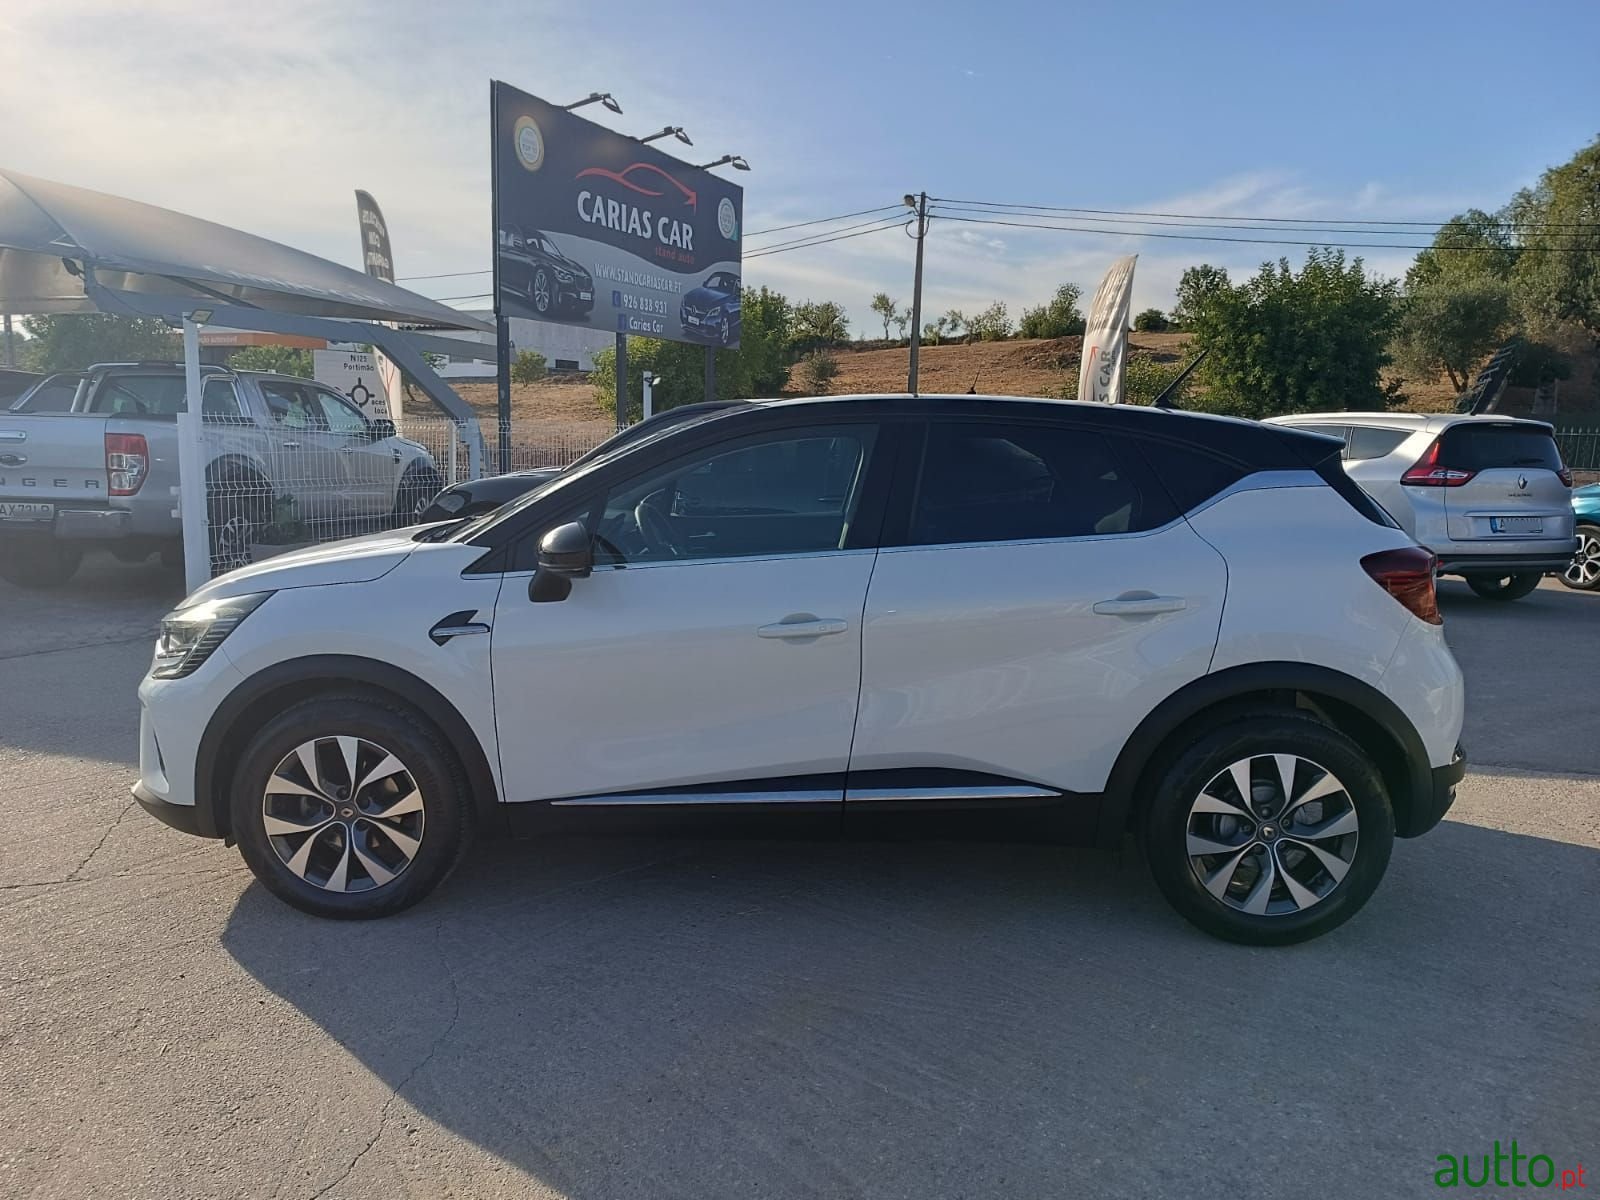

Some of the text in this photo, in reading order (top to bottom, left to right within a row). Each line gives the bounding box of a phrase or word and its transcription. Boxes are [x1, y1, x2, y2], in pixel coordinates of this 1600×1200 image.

[577, 191, 652, 239] CARIAS
[657, 217, 693, 250] CAR
[623, 294, 667, 314] 926 838 931
[343, 362, 375, 372] Portimão
[350, 354, 368, 363] N125
[1100, 350, 1111, 387] CAR
